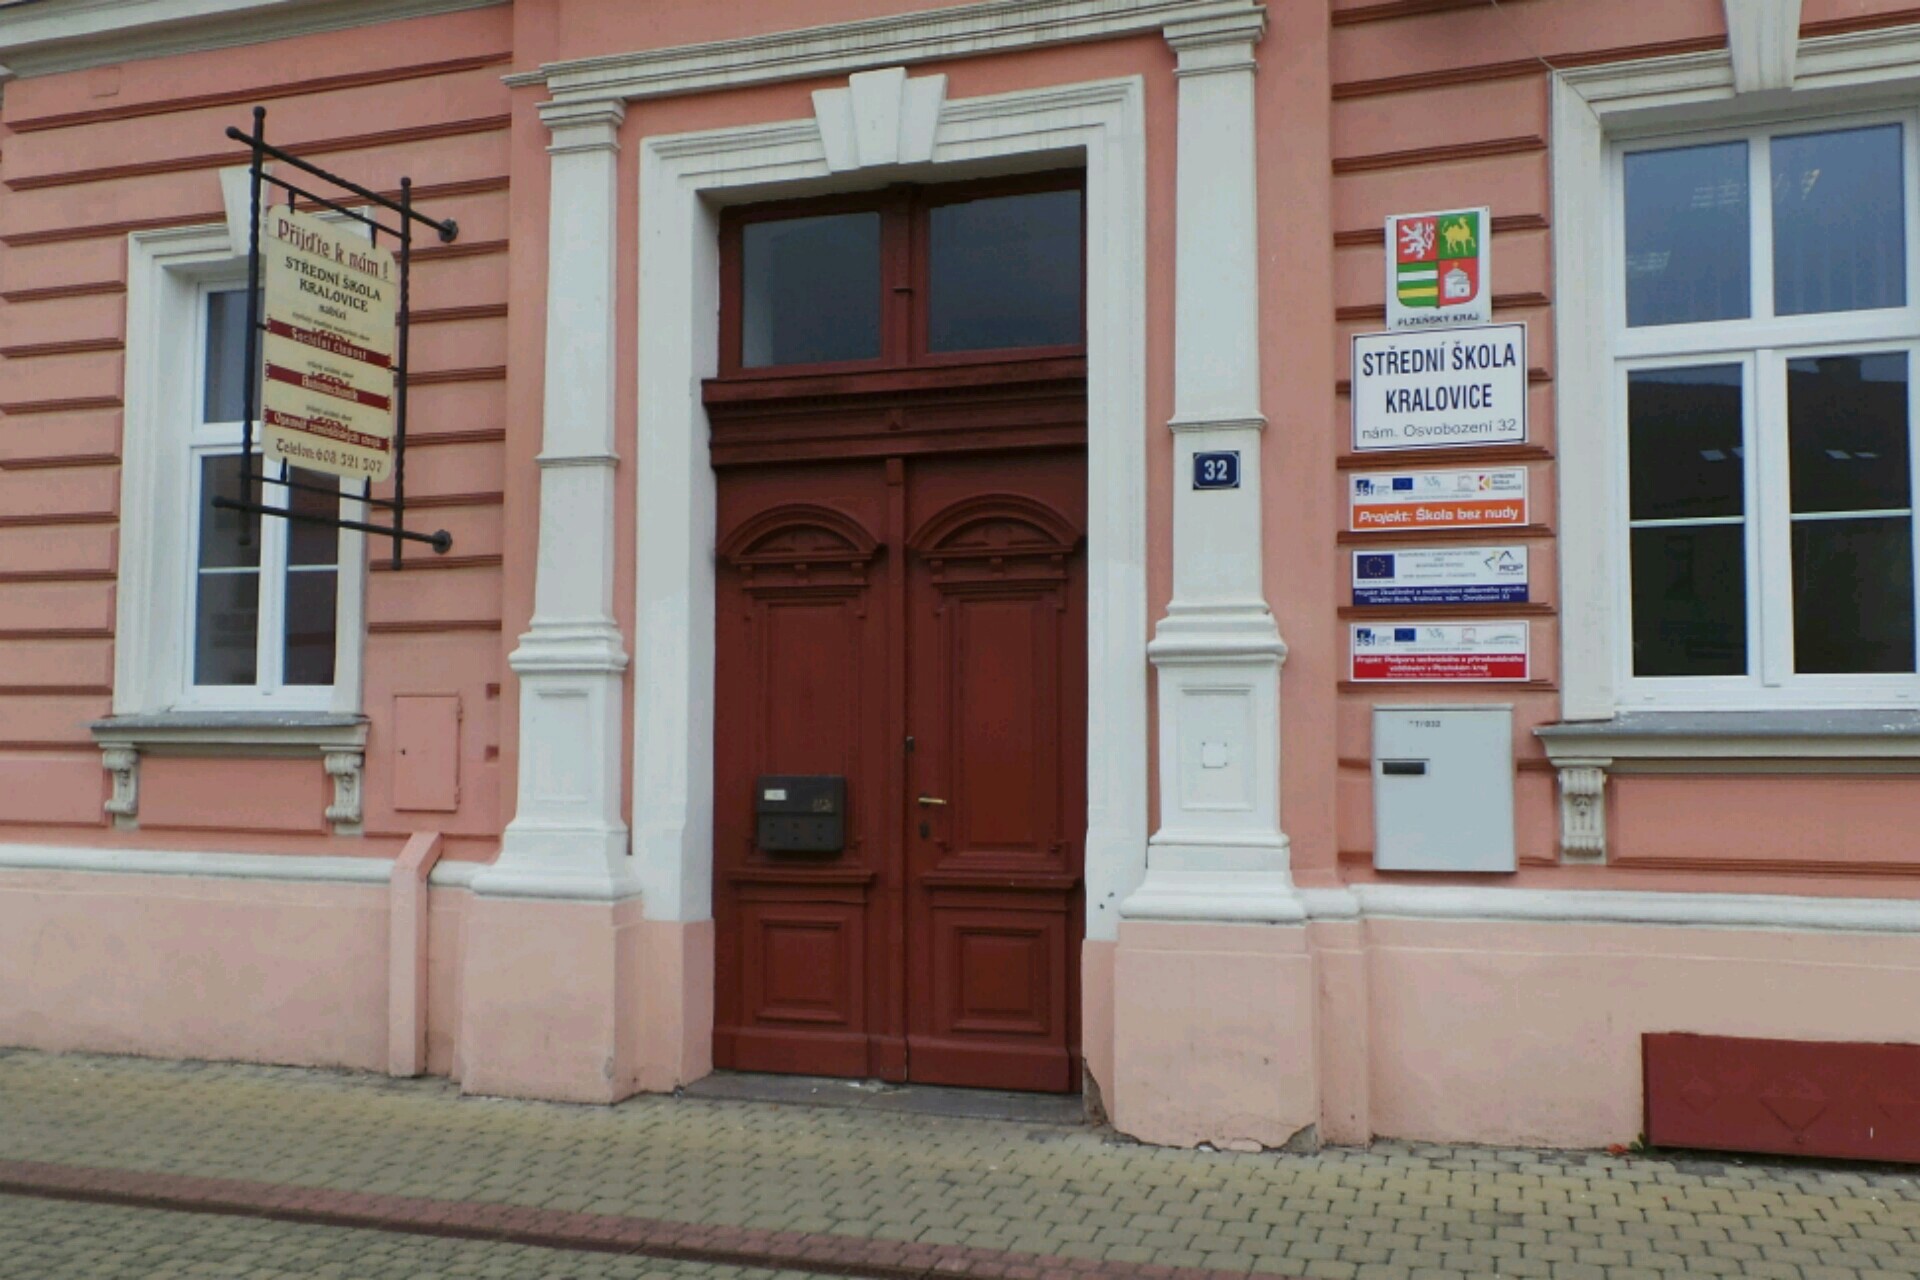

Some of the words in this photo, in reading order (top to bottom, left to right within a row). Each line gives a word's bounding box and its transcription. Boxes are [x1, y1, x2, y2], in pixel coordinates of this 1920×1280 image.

[278, 218, 329, 258] Přijďte
[335, 242, 345, 265] k
[349, 252, 379, 277] nám
[285, 255, 340, 287] STŘEDNÍ
[343, 274, 382, 301] ŠKOLA
[299, 278, 368, 312] KRALOVICE
[1452, 313, 1480, 322] KRAJ
[1362, 341, 1447, 377] STŘEDNÍ
[1451, 341, 1517, 371] ŠKOLA
[1385, 383, 1493, 414] KRALOVICE
[1362, 425, 1399, 440] nám.
[1403, 420, 1493, 438] Osvobození
[1497, 418, 1518, 432] 32
[1203, 459, 1228, 481] 32
[1358, 510, 1412, 525] Projekt:
[1415, 507, 1453, 522] Škola
[1457, 507, 1482, 520] bez
[1484, 506, 1519, 521] nudy
